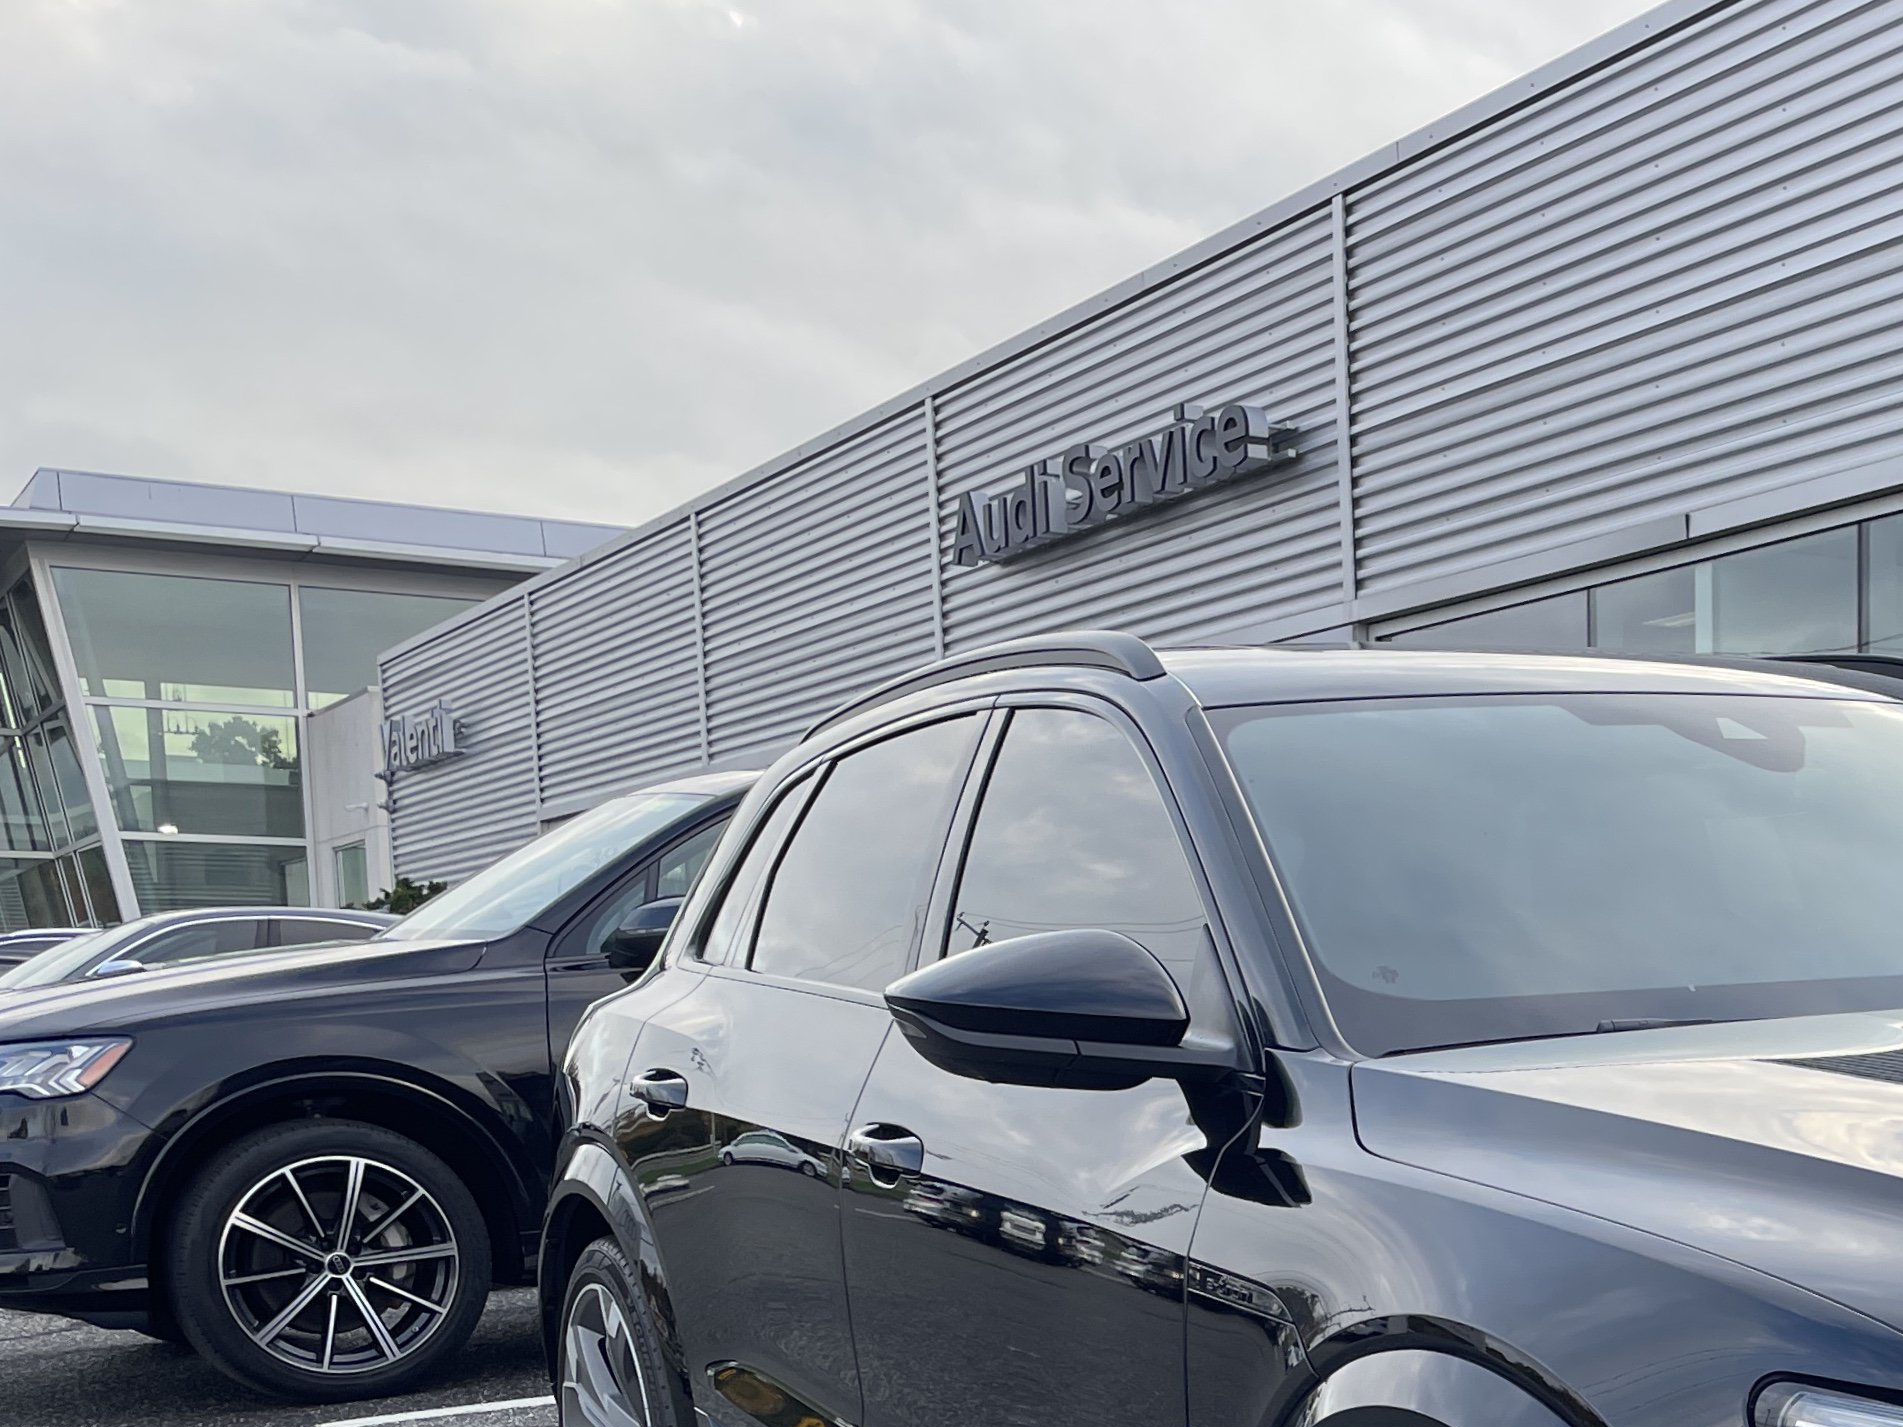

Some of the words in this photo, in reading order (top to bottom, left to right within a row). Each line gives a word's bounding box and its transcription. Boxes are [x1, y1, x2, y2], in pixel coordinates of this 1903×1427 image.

[952, 459, 1063, 566] Audi
[1063, 403, 1258, 525] Service
[380, 699, 452, 772] Valenti
